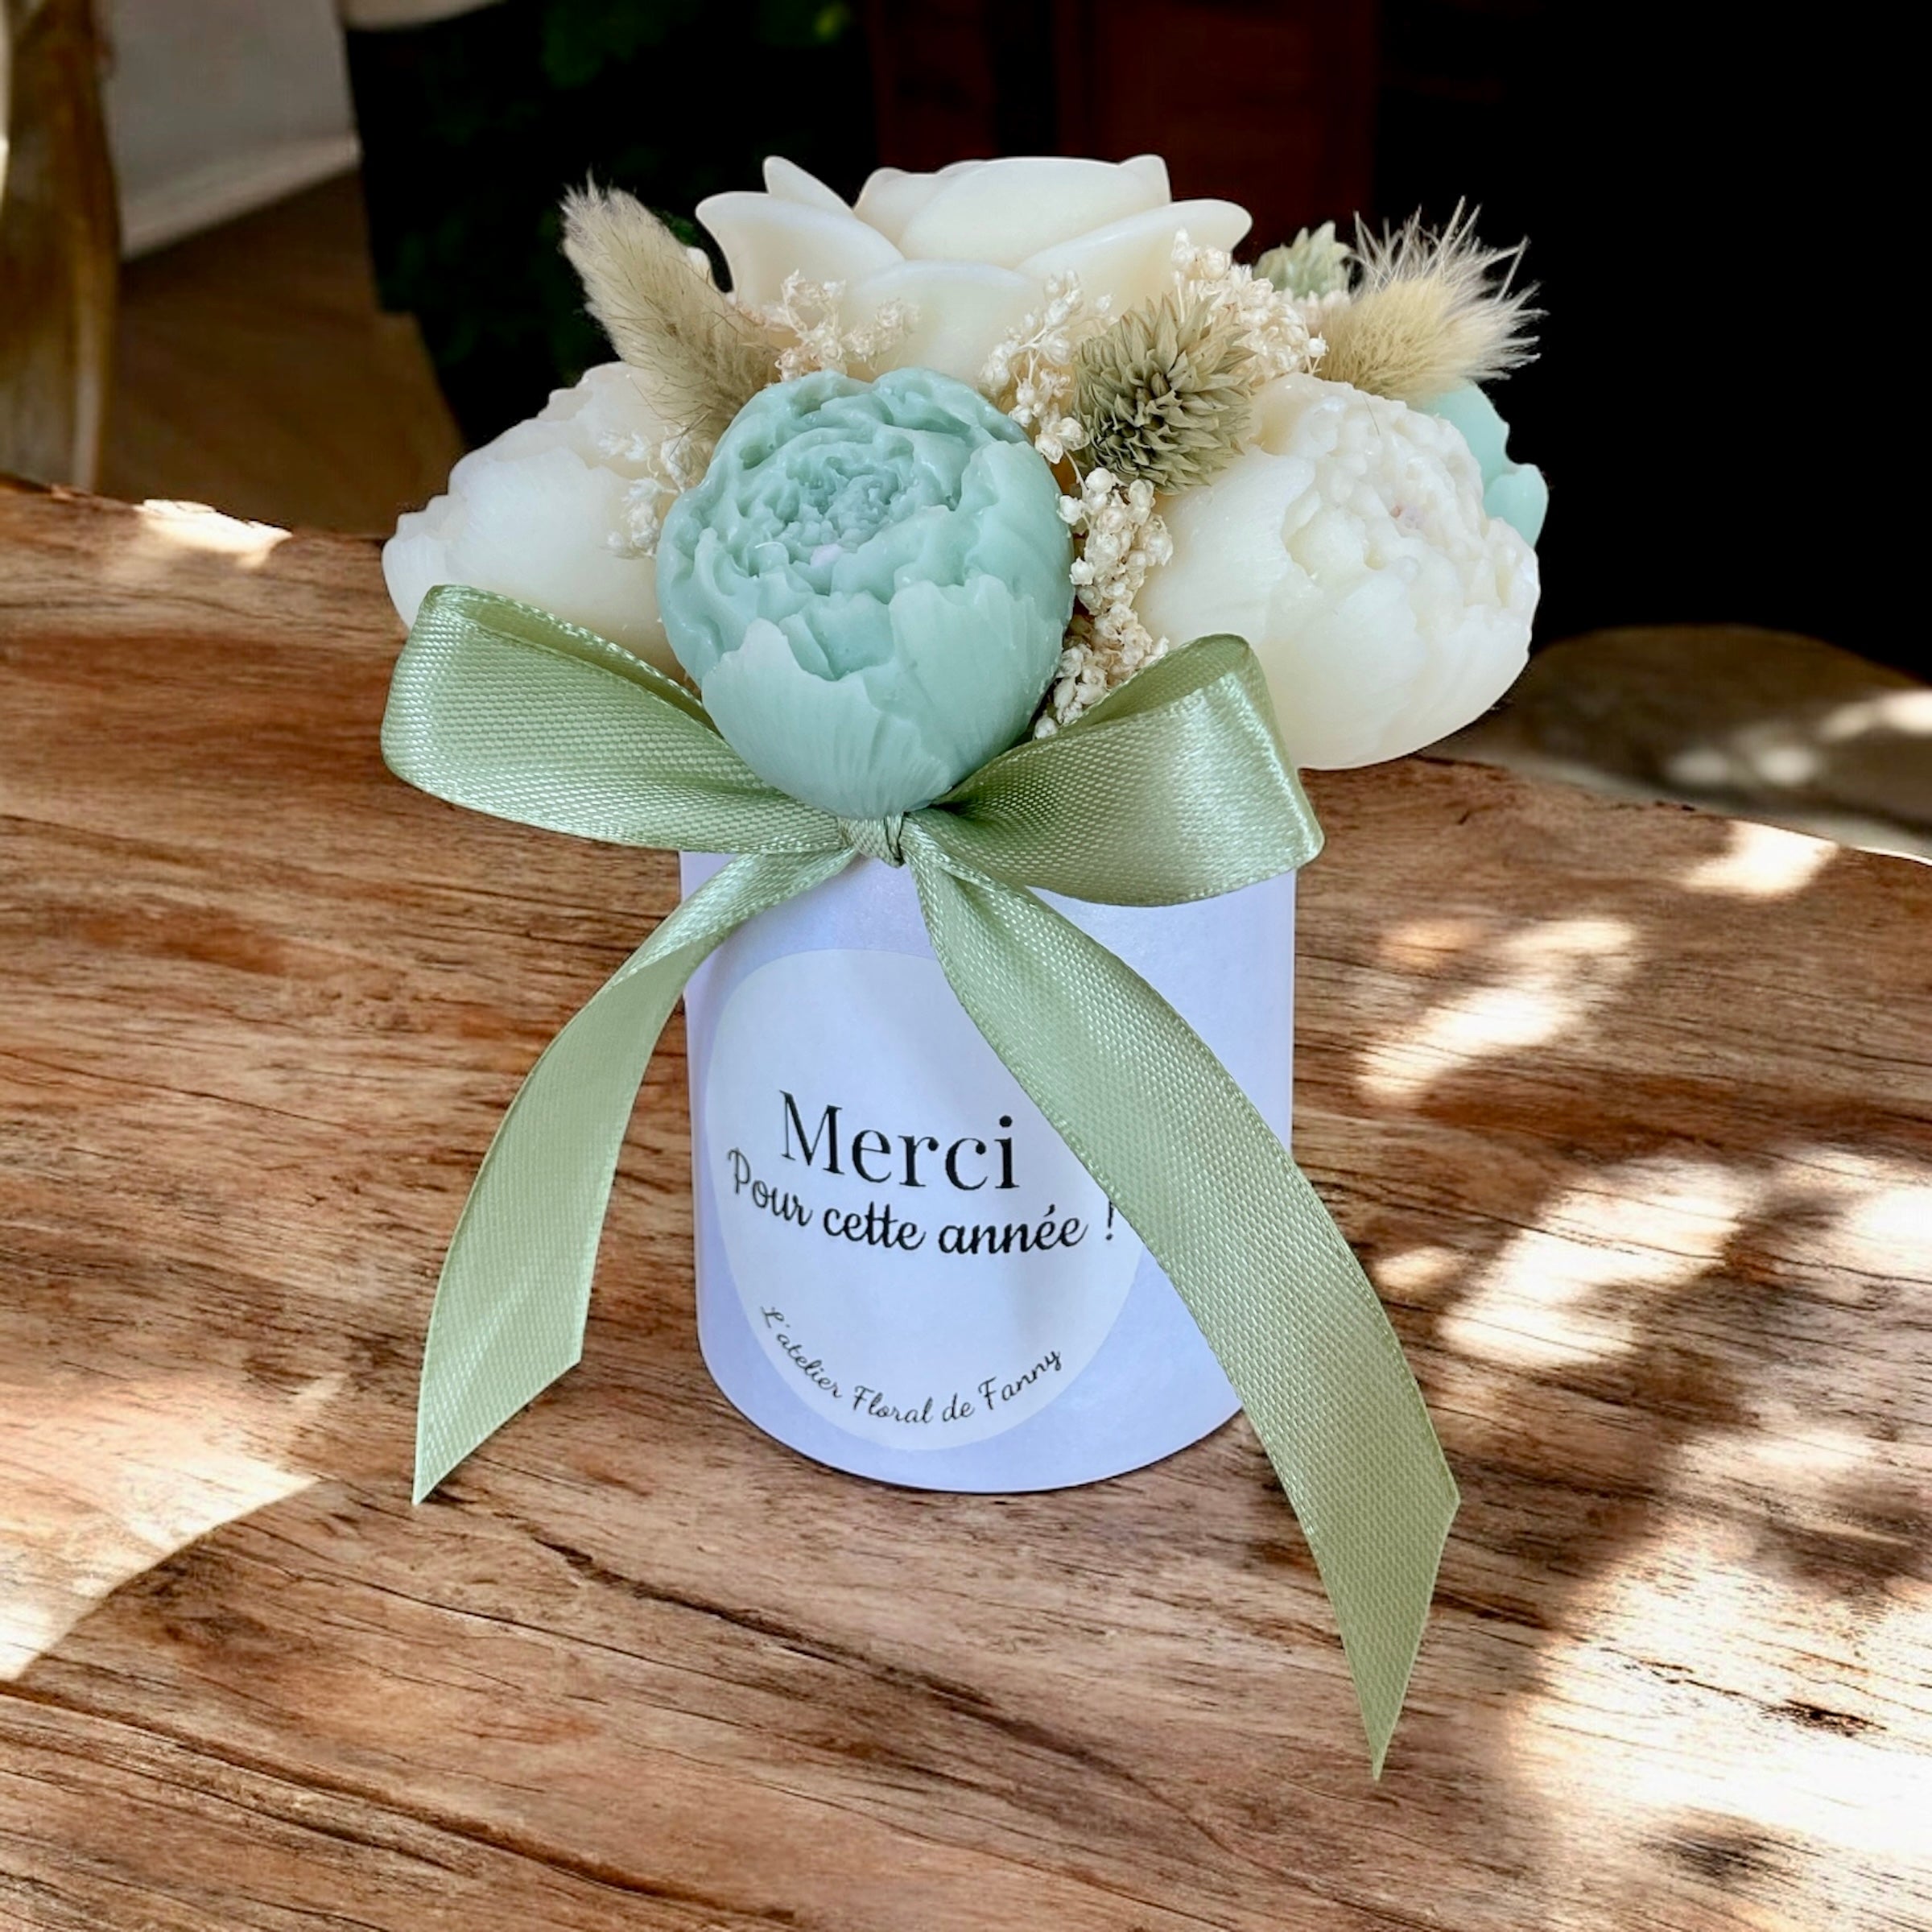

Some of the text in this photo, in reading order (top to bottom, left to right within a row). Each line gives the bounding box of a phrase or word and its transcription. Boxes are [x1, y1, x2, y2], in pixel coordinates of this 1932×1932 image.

[778, 1089, 1021, 1191] Merci
[727, 1147, 1115, 1256] Pour cette année !
[761, 1305, 1062, 1425] L'atelier Floral de Fanny
